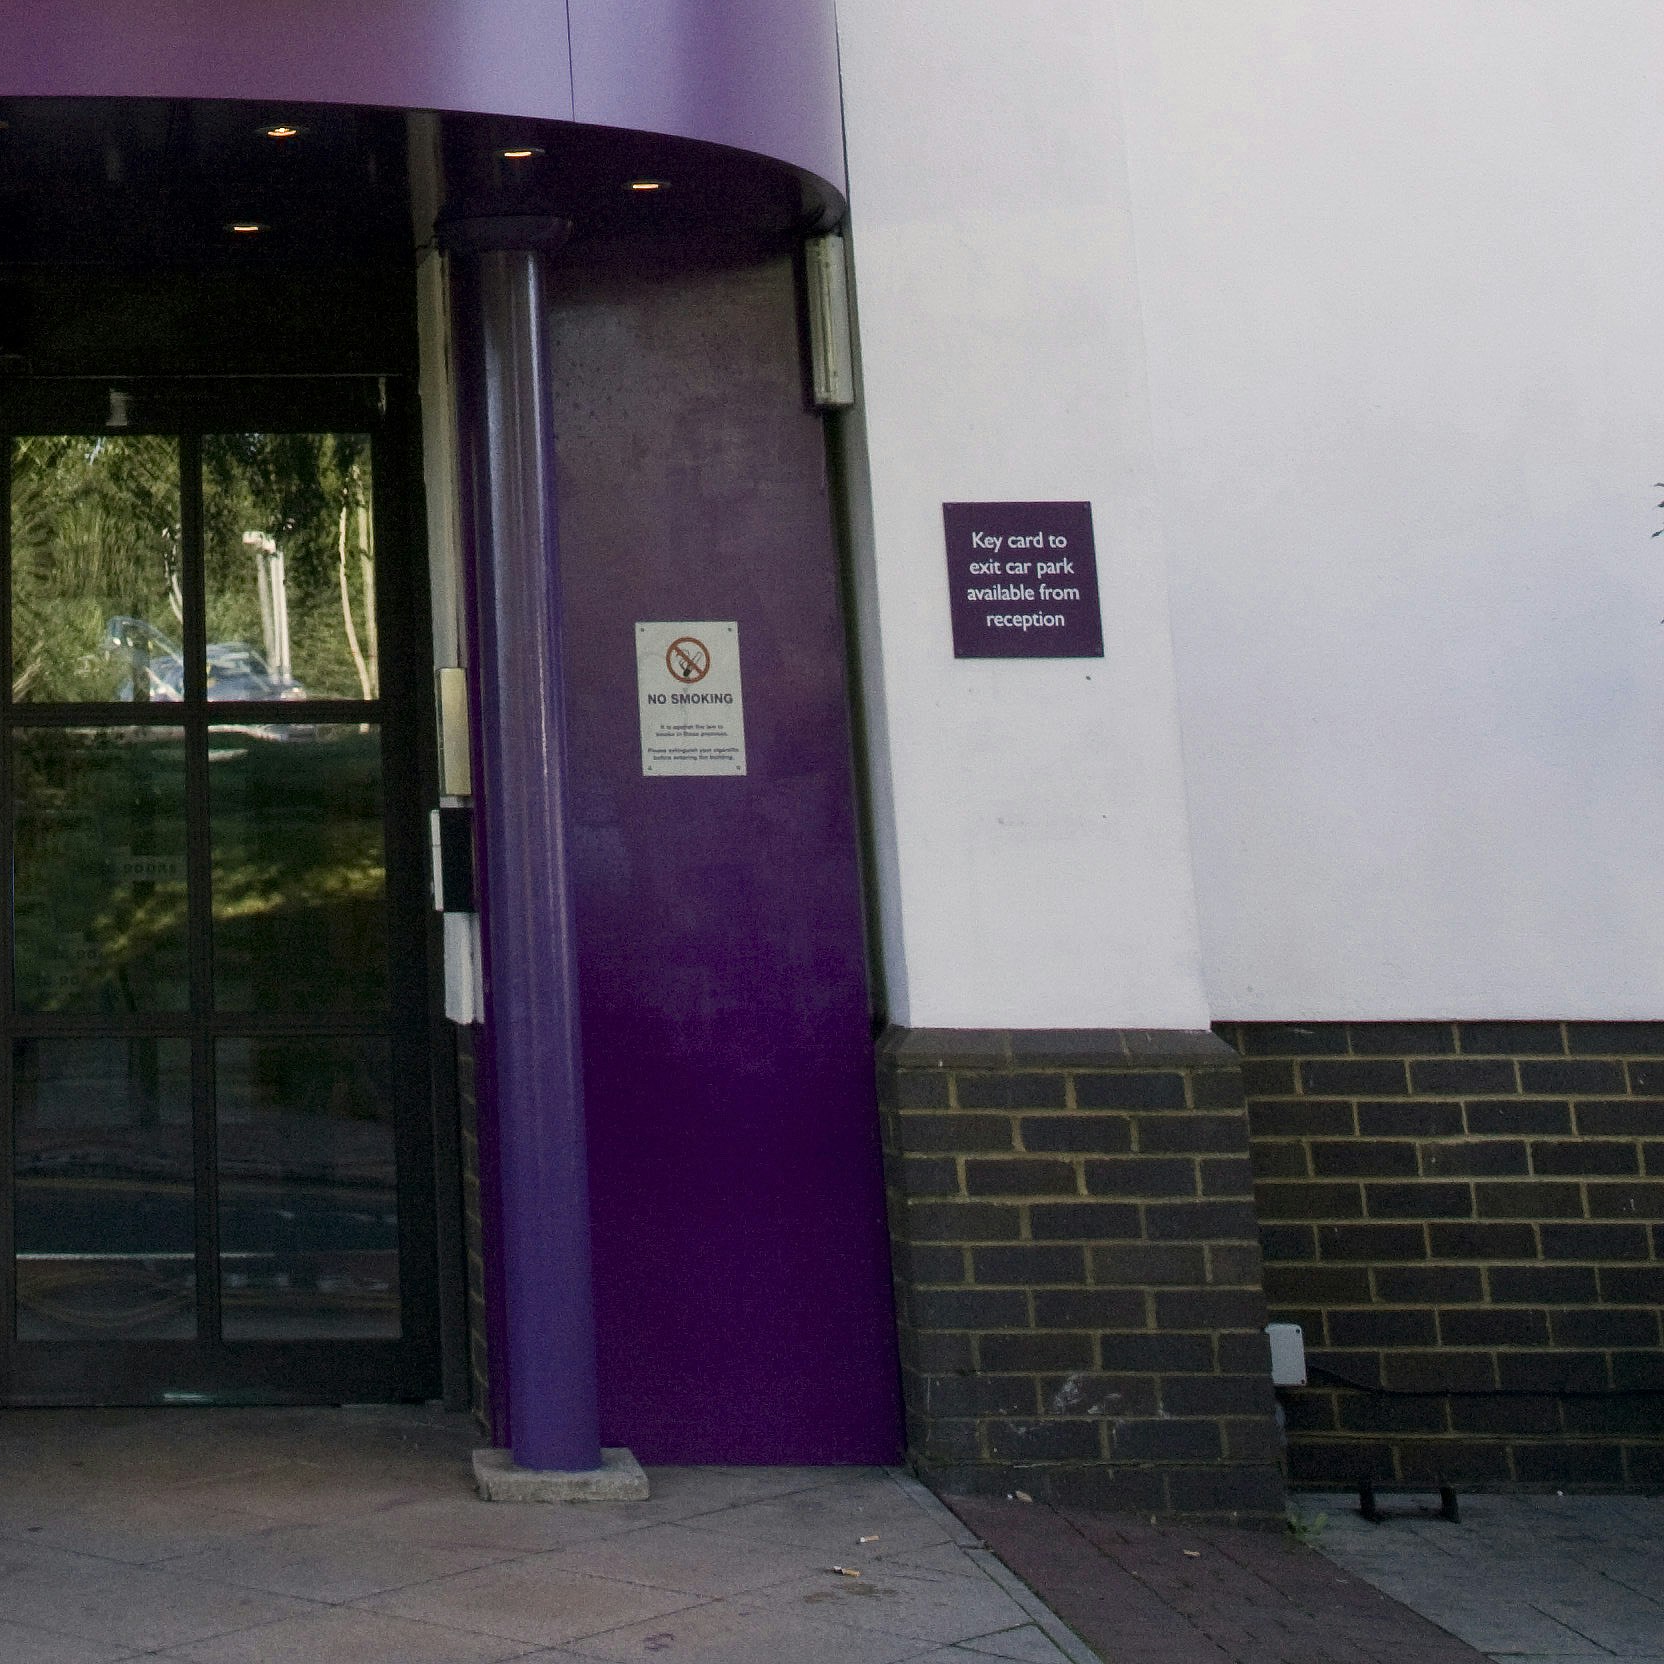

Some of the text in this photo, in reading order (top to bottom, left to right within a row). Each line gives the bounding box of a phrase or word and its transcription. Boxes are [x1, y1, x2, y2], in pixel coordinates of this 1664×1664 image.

[972, 531, 1068, 553] Key card to
[969, 557, 1075, 579] exit car park
[967, 583, 1080, 601] available from
[986, 611, 1065, 631] reception
[647, 693, 733, 705] NO SMOKING
